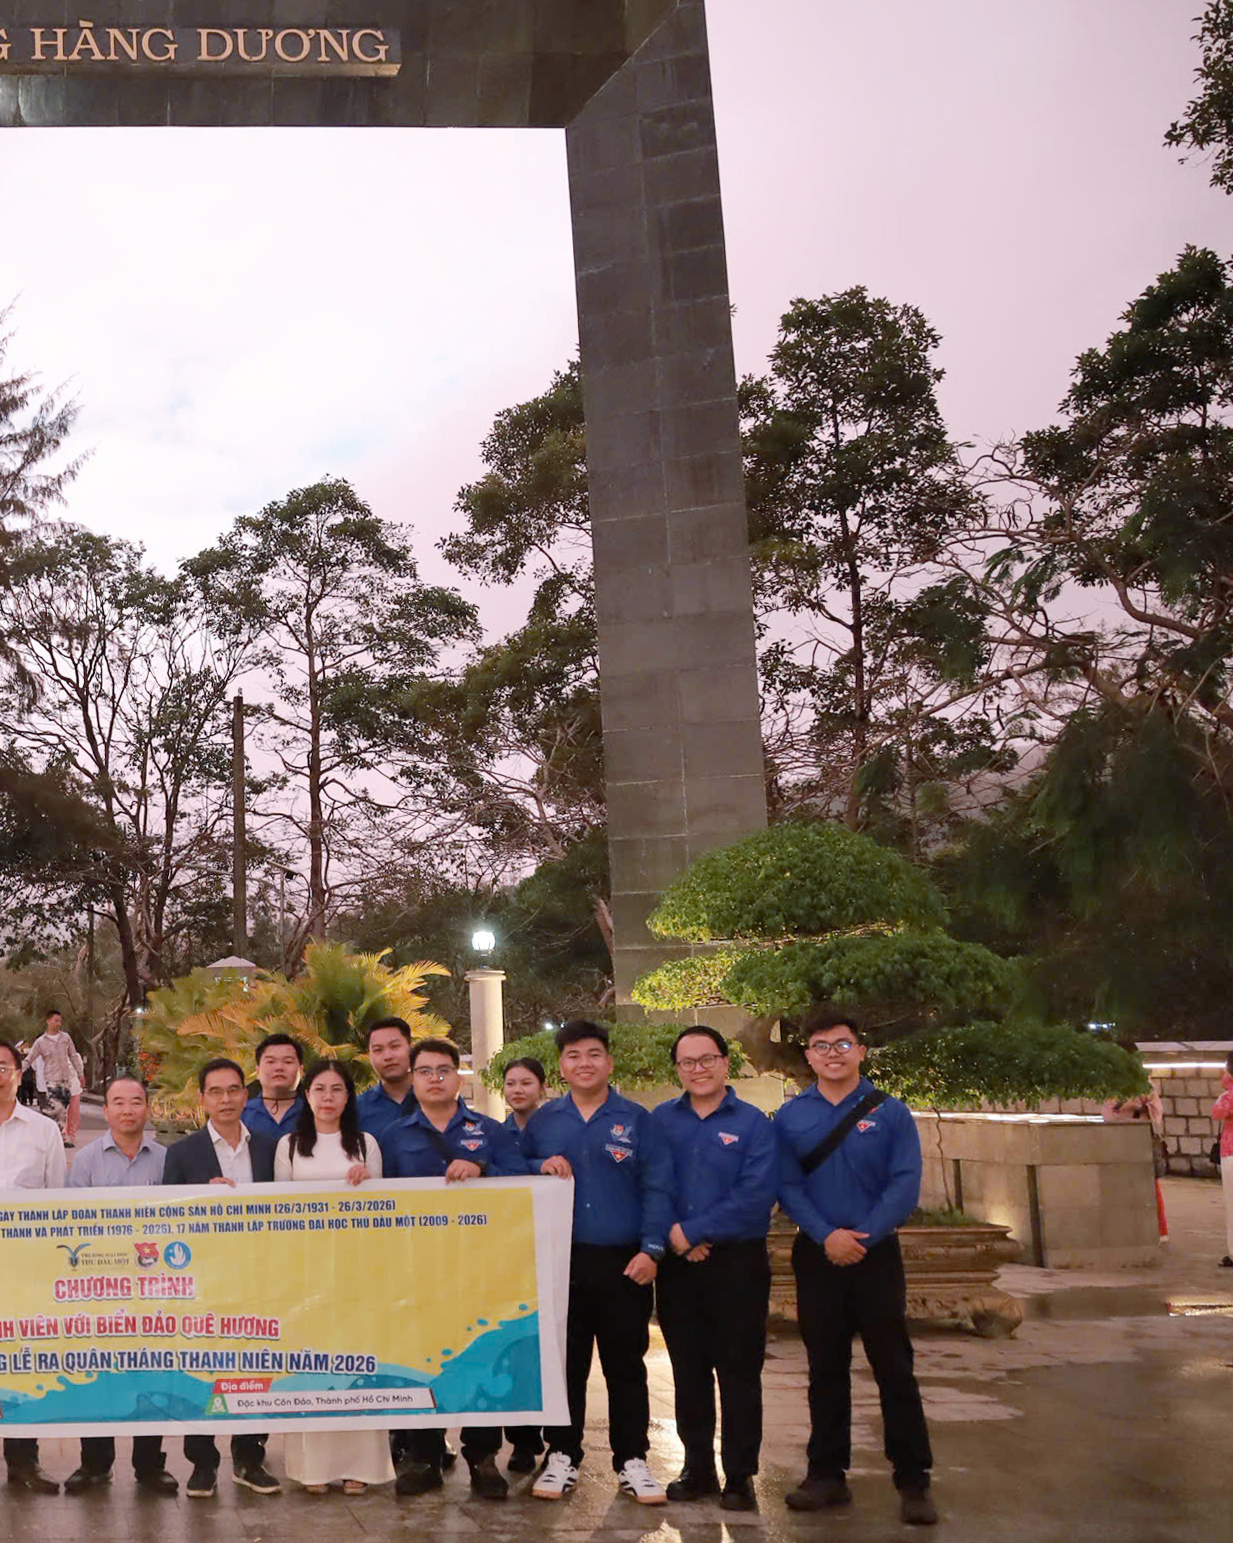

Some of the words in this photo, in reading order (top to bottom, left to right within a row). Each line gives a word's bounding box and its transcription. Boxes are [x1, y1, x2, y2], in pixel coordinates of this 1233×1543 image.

[29, 19, 179, 62] HÀNG
[196, 26, 390, 63] DƯƠNG
[100, 1208, 132, 1219] THANH
[134, 1205, 156, 1218] NIÊN
[246, 1203, 272, 1215] MINH
[274, 1202, 329, 1215] (26/3/1931
[338, 1199, 396, 1213] 26/3/2026)
[106, 1223, 133, 1236] (1976
[176, 1222, 186, 1234] 17
[418, 1214, 449, 1227] (2009
[457, 1213, 488, 1226] 2026)
[54, 1275, 132, 1300] CHƯƠNG
[137, 1272, 195, 1298] TRÌNH
[18, 1315, 59, 1339] VIÊN
[63, 1315, 92, 1338] VỚI
[96, 1308, 136, 1335] BIỂN
[142, 1310, 177, 1335] ĐẢO
[181, 1312, 216, 1338] QUÊ
[220, 1316, 280, 1338] HƯƠNG
[12, 1346, 33, 1372] LỄ
[38, 1353, 60, 1371] RA
[65, 1348, 112, 1372] QUÂN
[118, 1347, 174, 1371] THÁNG
[180, 1351, 236, 1370] THANH
[242, 1348, 283, 1371] NIÊN
[289, 1348, 330, 1373] NĂM
[334, 1354, 376, 1374] 2026
[257, 1398, 273, 1407] khu
[392, 1394, 414, 1403] Minh
